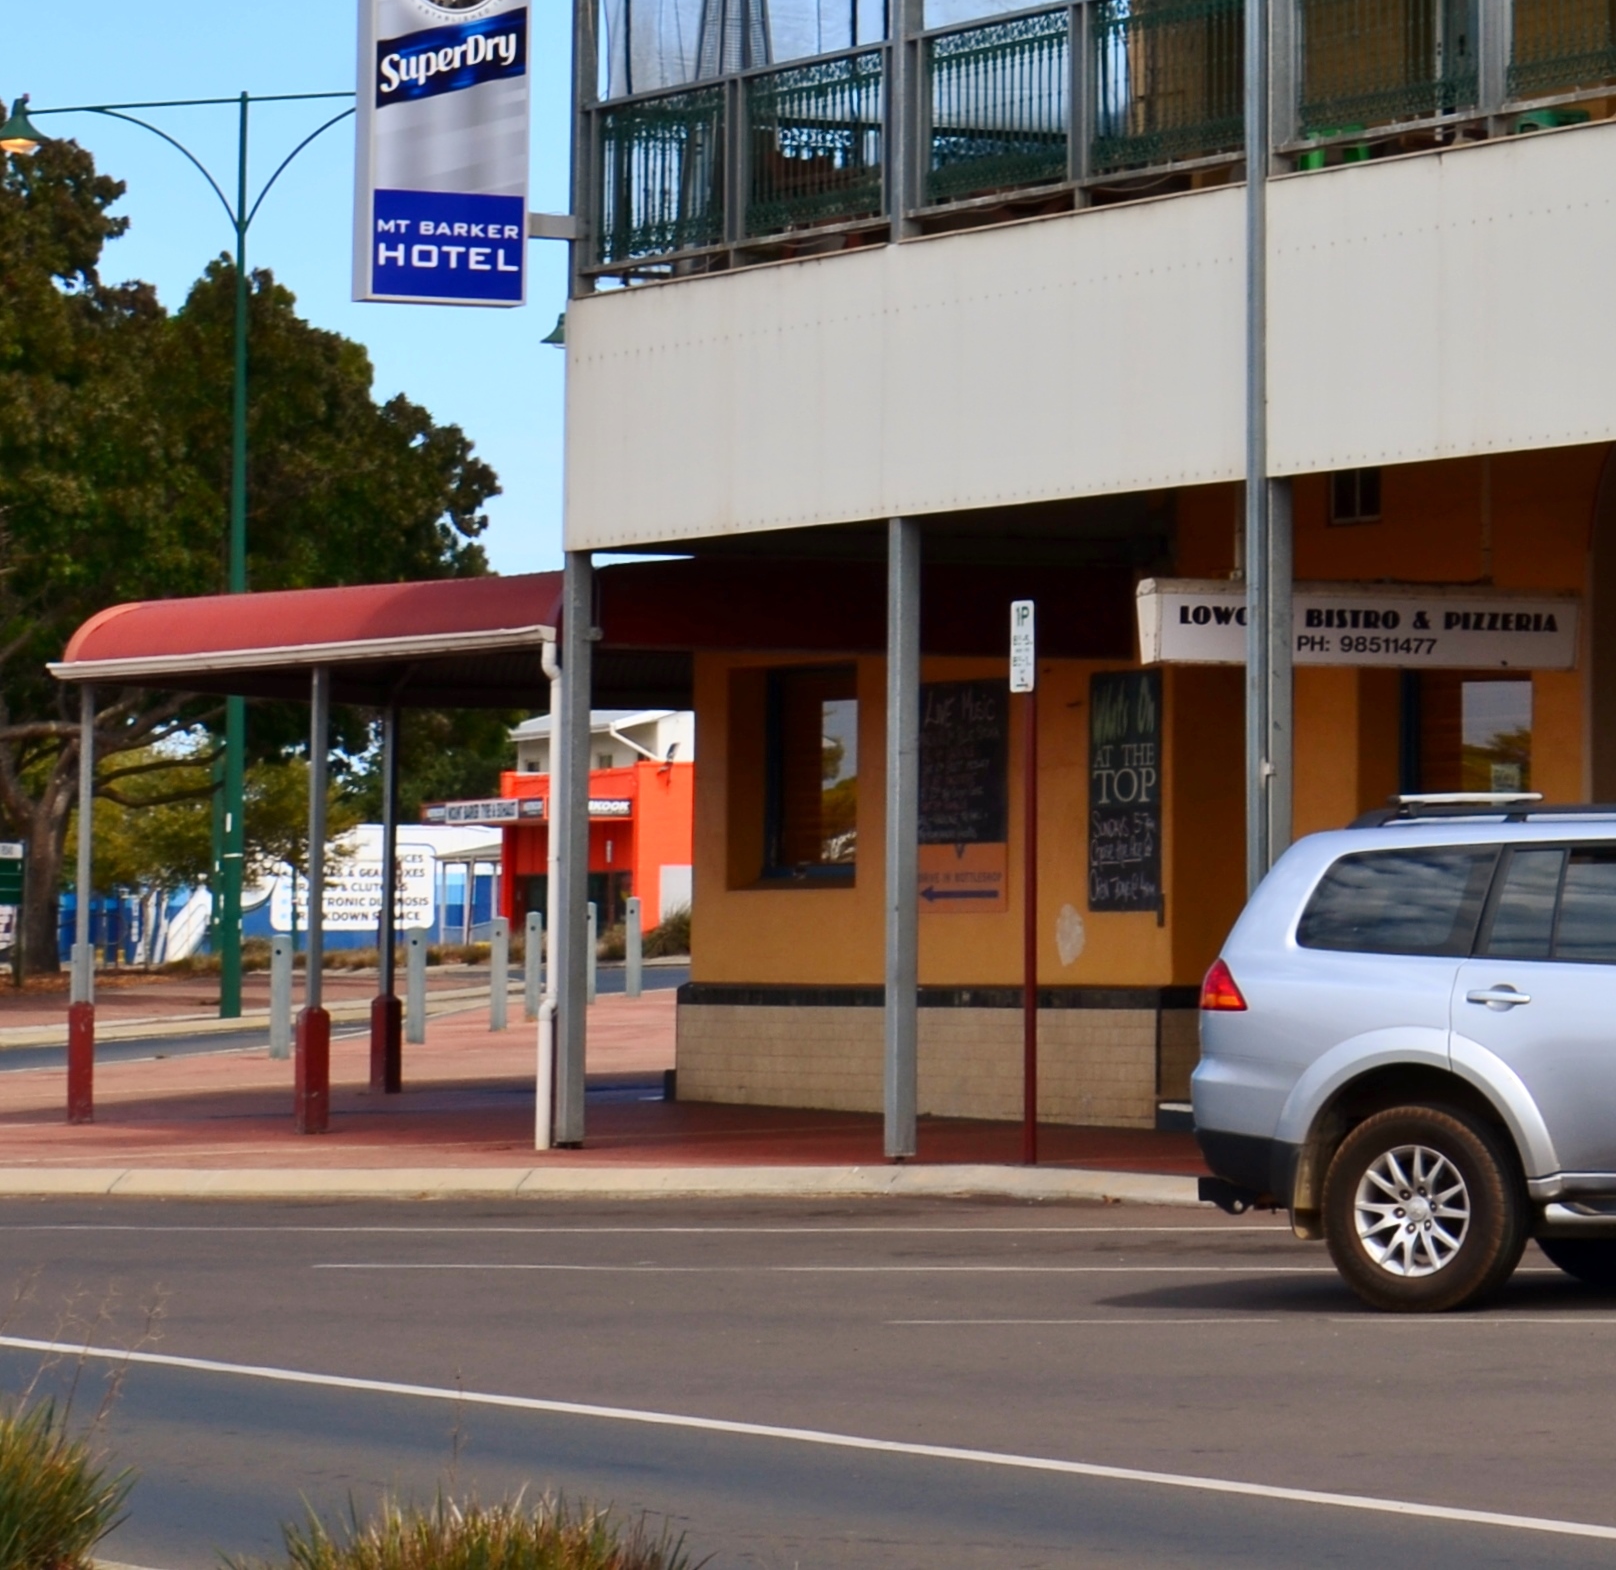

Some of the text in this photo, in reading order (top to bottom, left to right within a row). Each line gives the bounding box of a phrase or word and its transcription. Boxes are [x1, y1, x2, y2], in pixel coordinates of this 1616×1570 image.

[380, 33, 517, 93] SuperDry
[377, 219, 519, 239] MT BARKER
[378, 242, 520, 272] HOTEL
[1305, 608, 1400, 631] BISTRO
[1412, 611, 1431, 630] &
[1444, 611, 1559, 633] PIZZERIA
[1297, 635, 1437, 655] PH: 98511477
[1093, 742, 1155, 768] AT THE
[1092, 767, 1156, 804] TOP
